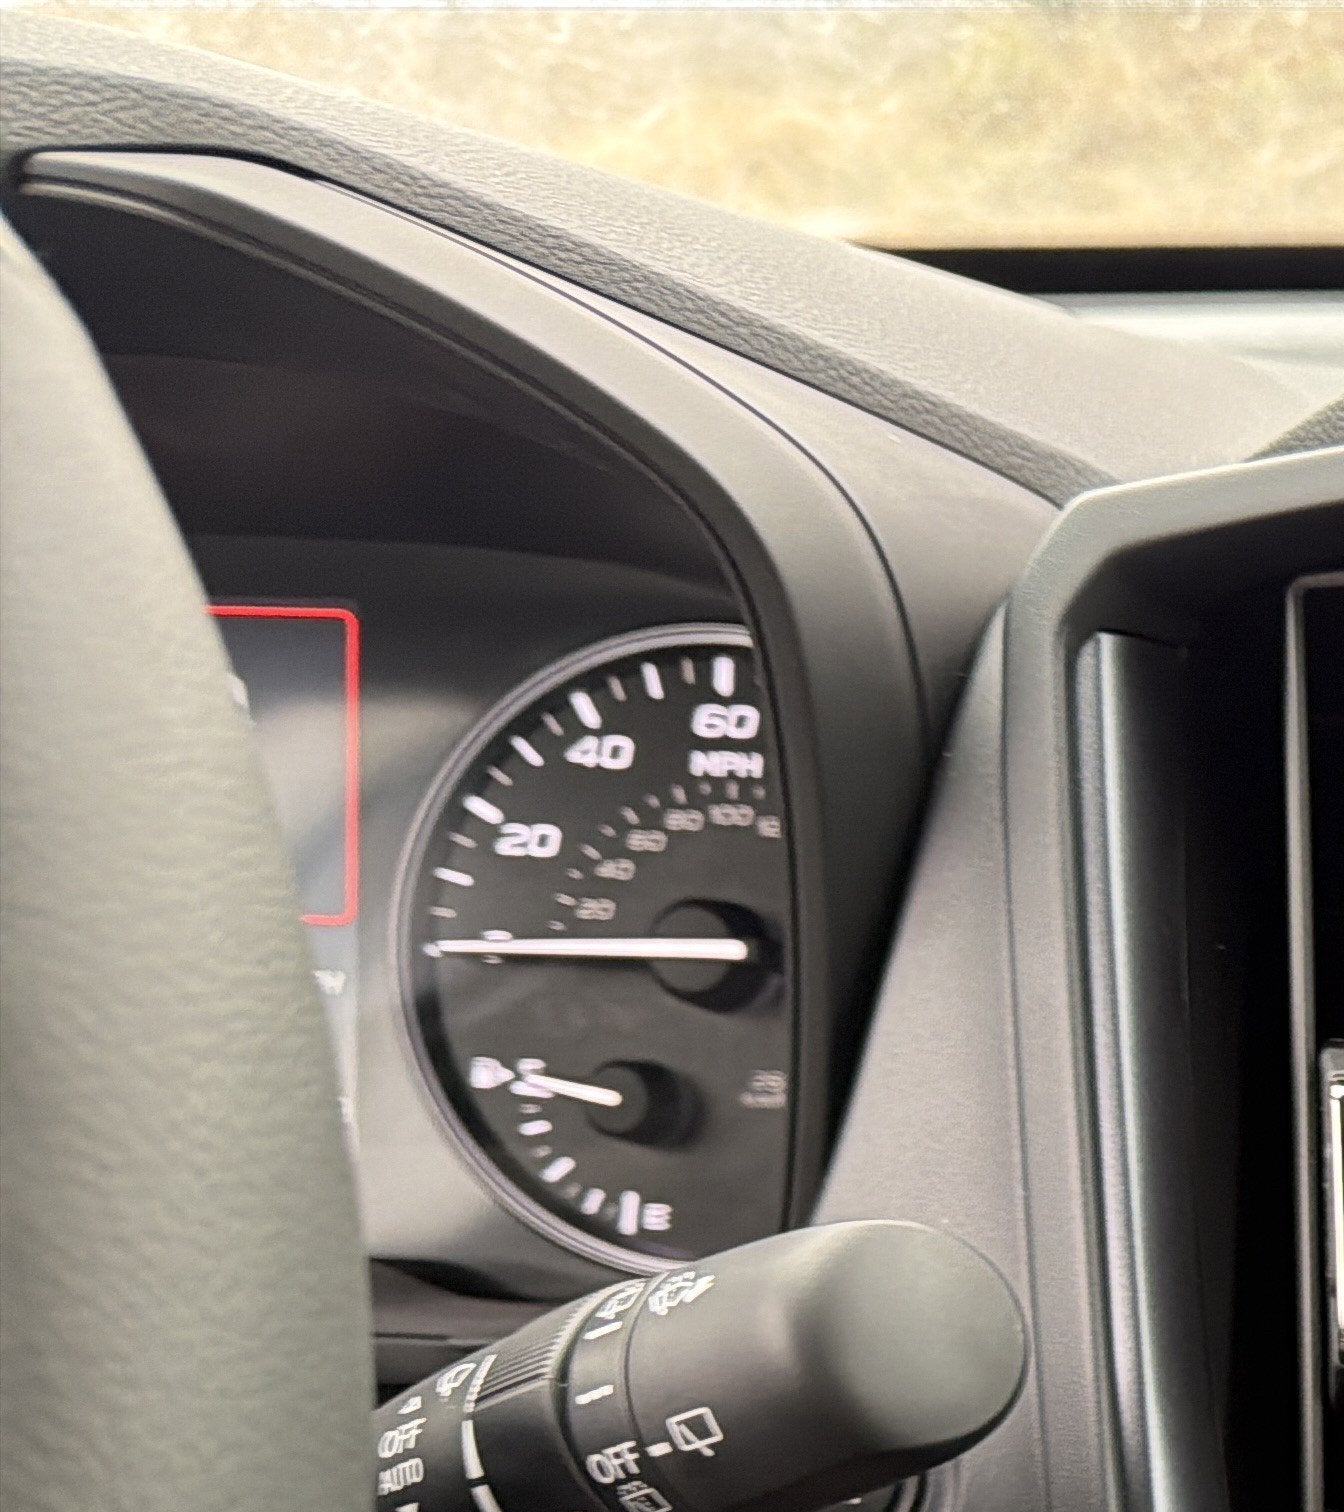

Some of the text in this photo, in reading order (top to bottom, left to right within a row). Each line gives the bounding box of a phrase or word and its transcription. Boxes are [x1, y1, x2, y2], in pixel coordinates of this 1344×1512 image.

[691, 703, 761, 740] 60
[564, 734, 636, 770] 40
[495, 822, 563, 858] 20
[378, 1417, 427, 1458] OFF
[586, 1440, 640, 1484] OFF
